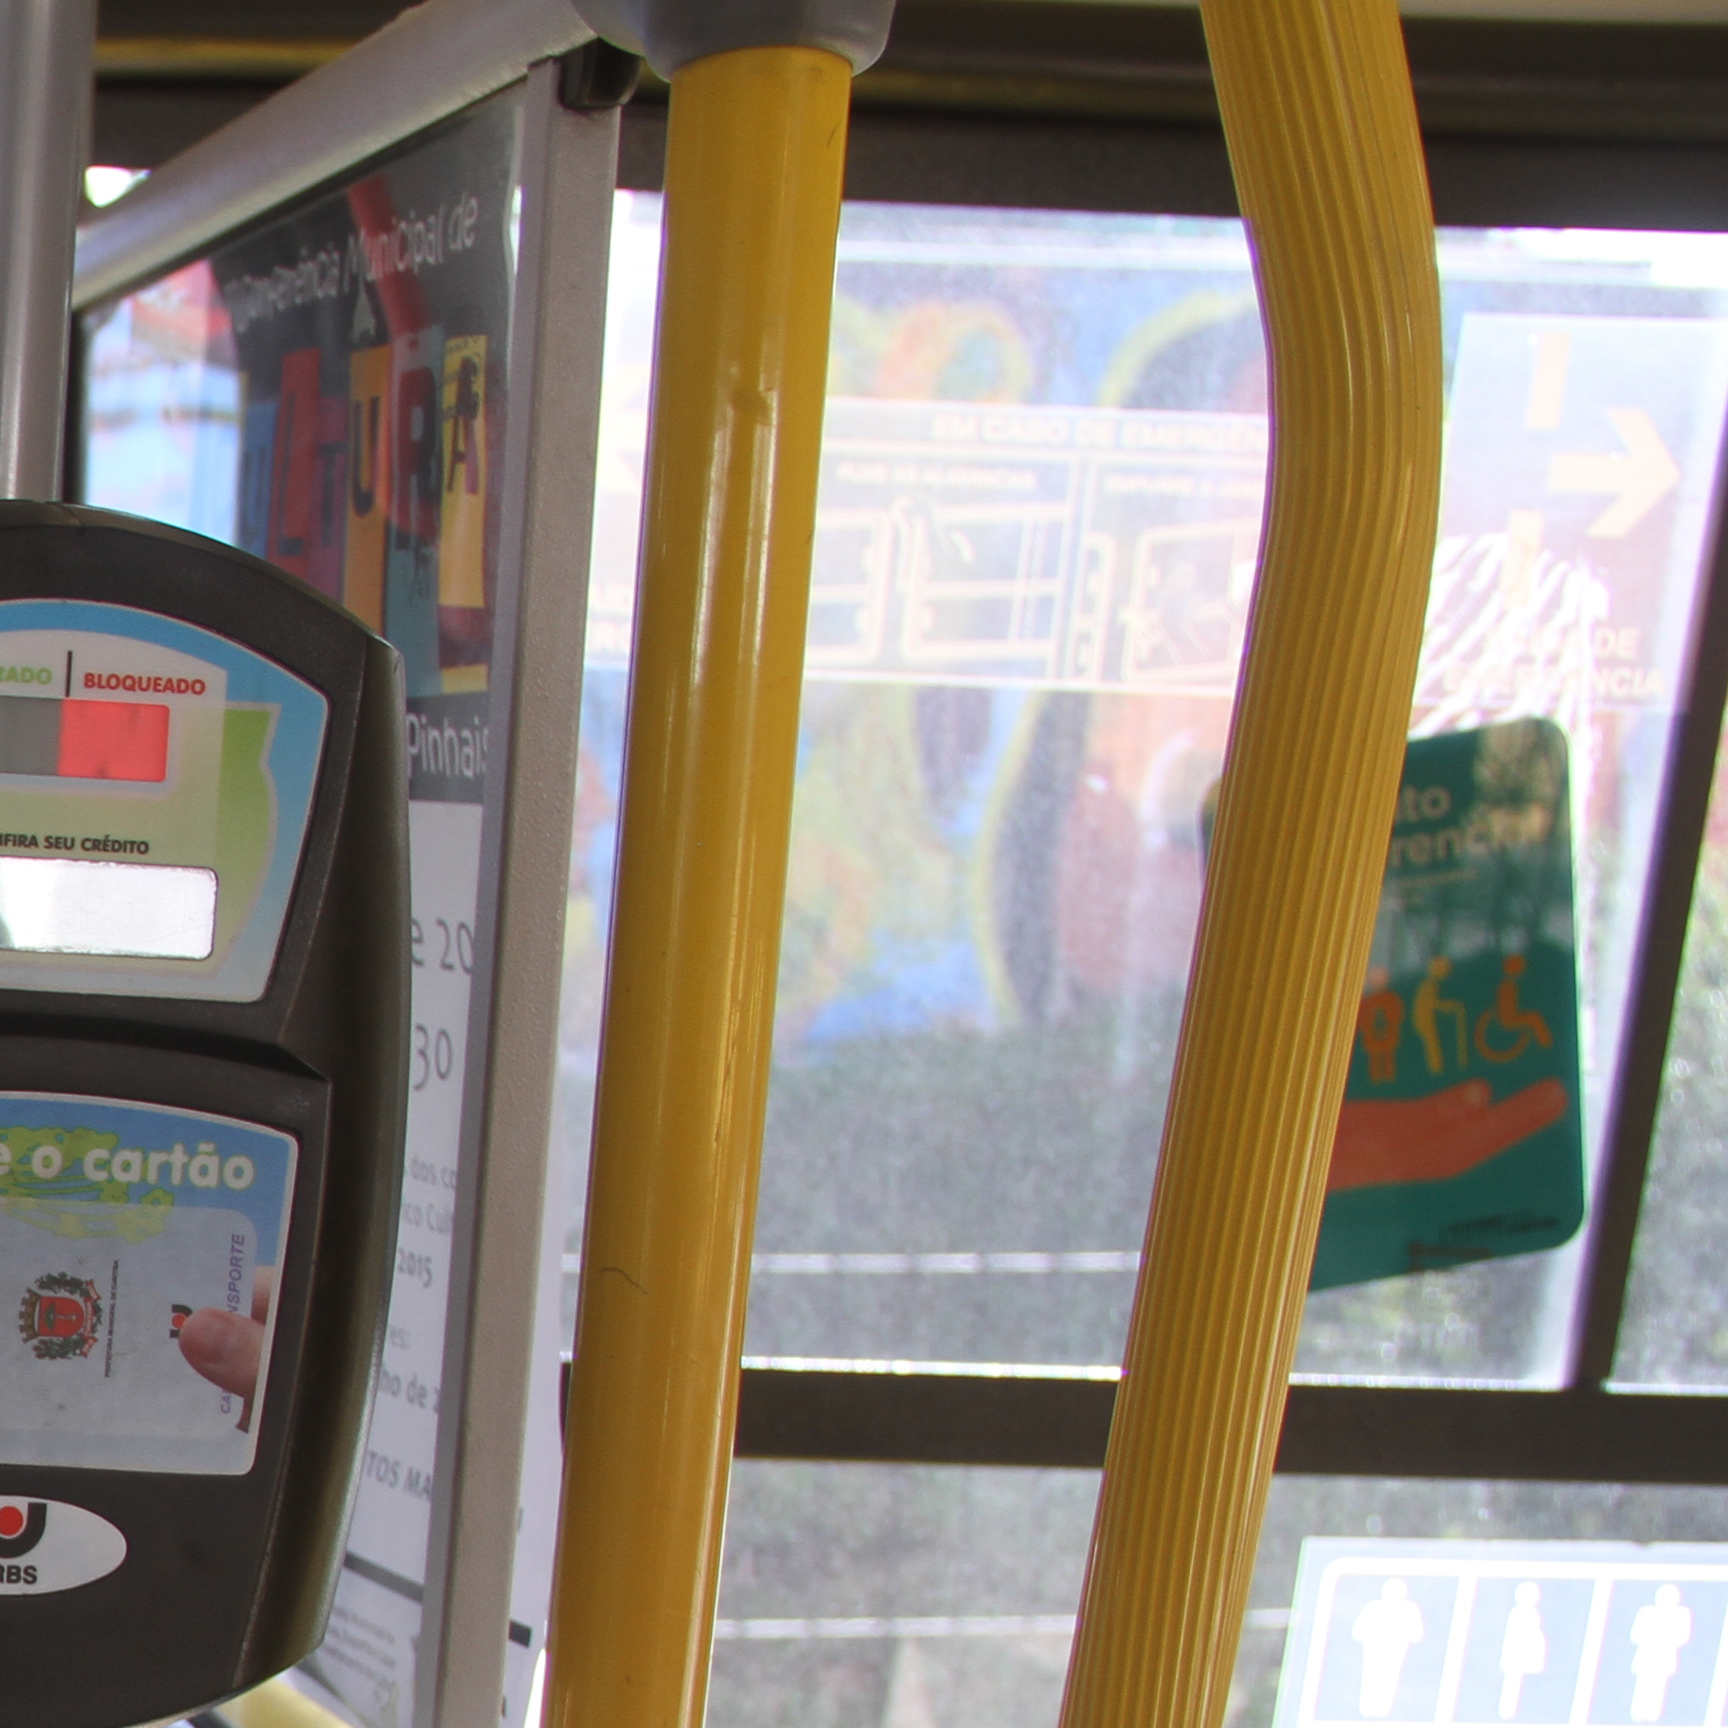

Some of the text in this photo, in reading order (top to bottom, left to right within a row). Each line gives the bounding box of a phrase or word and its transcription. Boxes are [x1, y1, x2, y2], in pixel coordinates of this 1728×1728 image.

[449, 191, 479, 251] de
[83, 672, 206, 696] BLOQUEADO
[44, 834, 75, 851] SEU
[80, 834, 150, 855] CRÉDITO
[31, 1145, 62, 1180] o
[82, 1140, 256, 1191] cartão
